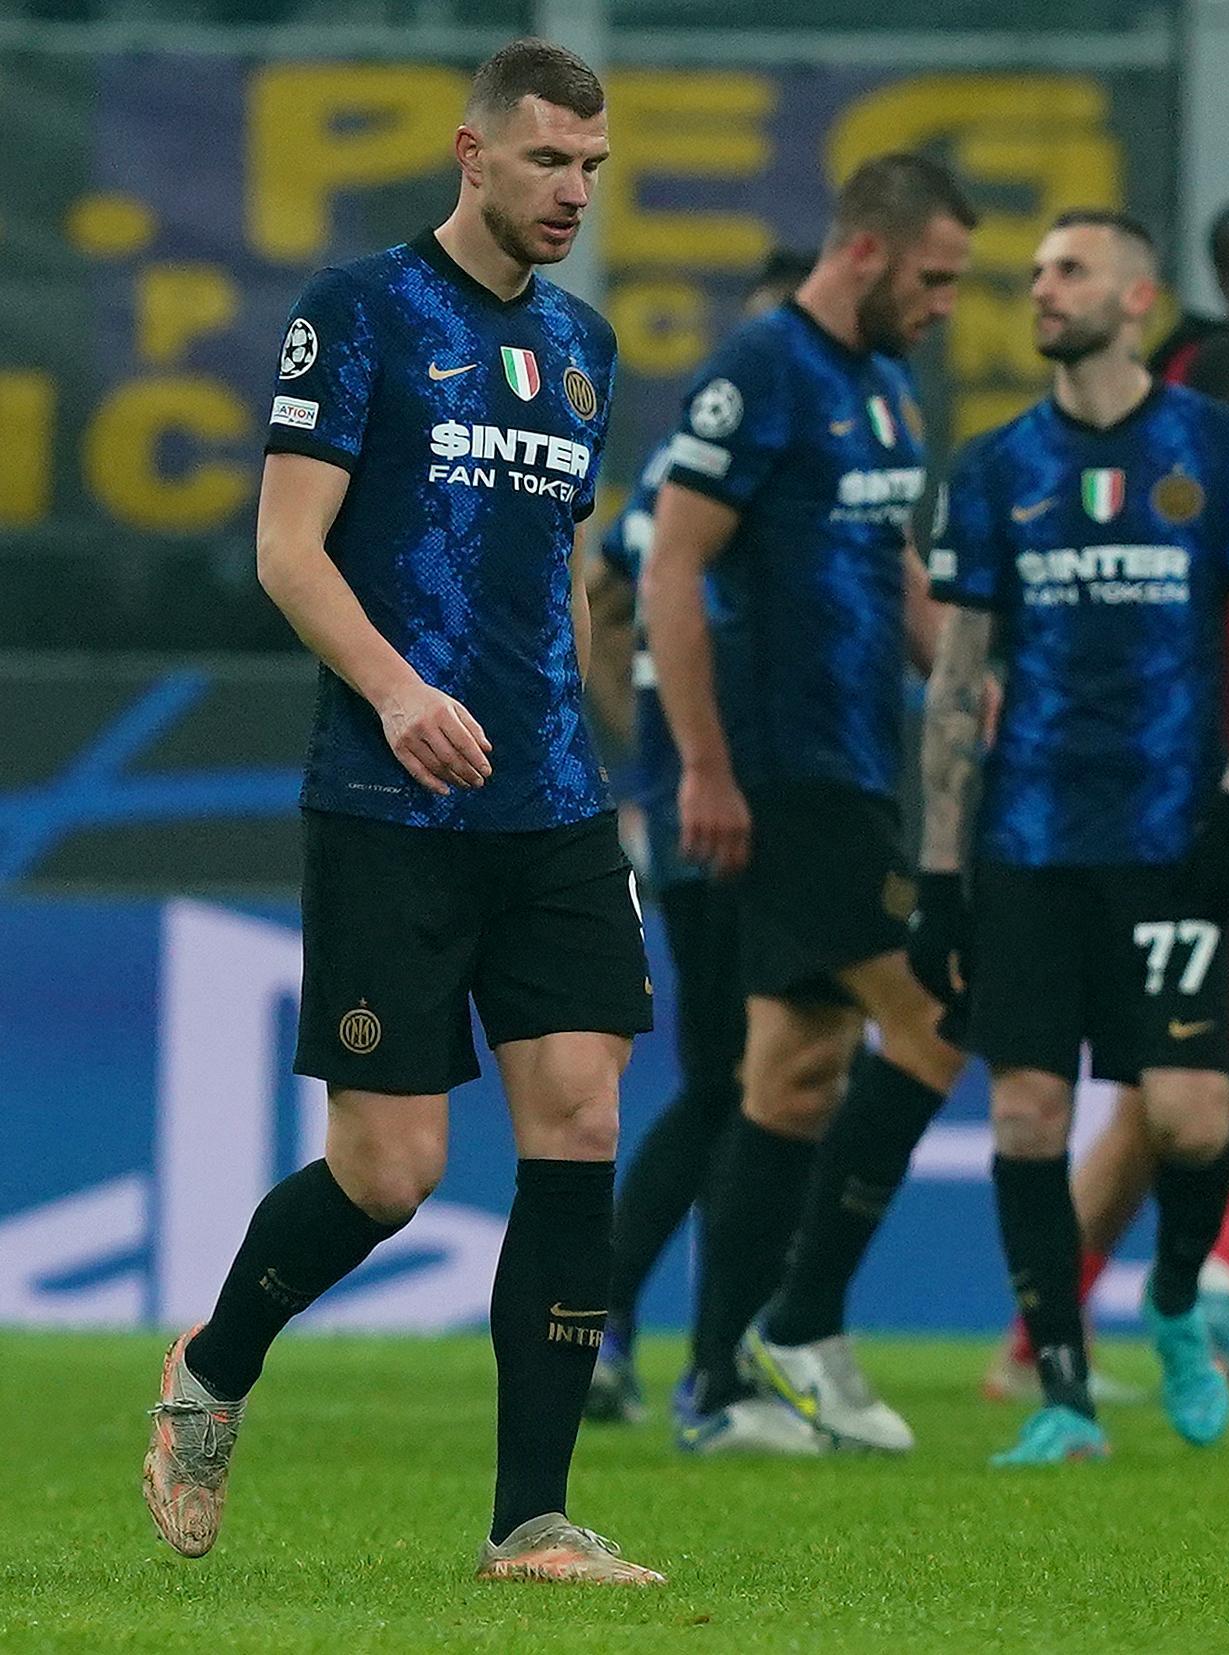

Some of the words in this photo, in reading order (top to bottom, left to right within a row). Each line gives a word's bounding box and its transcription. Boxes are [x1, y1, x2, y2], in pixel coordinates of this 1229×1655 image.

[428, 464, 496, 488] FAN
[429, 419, 590, 479] $INTER
[1132, 919, 1220, 995] 77
